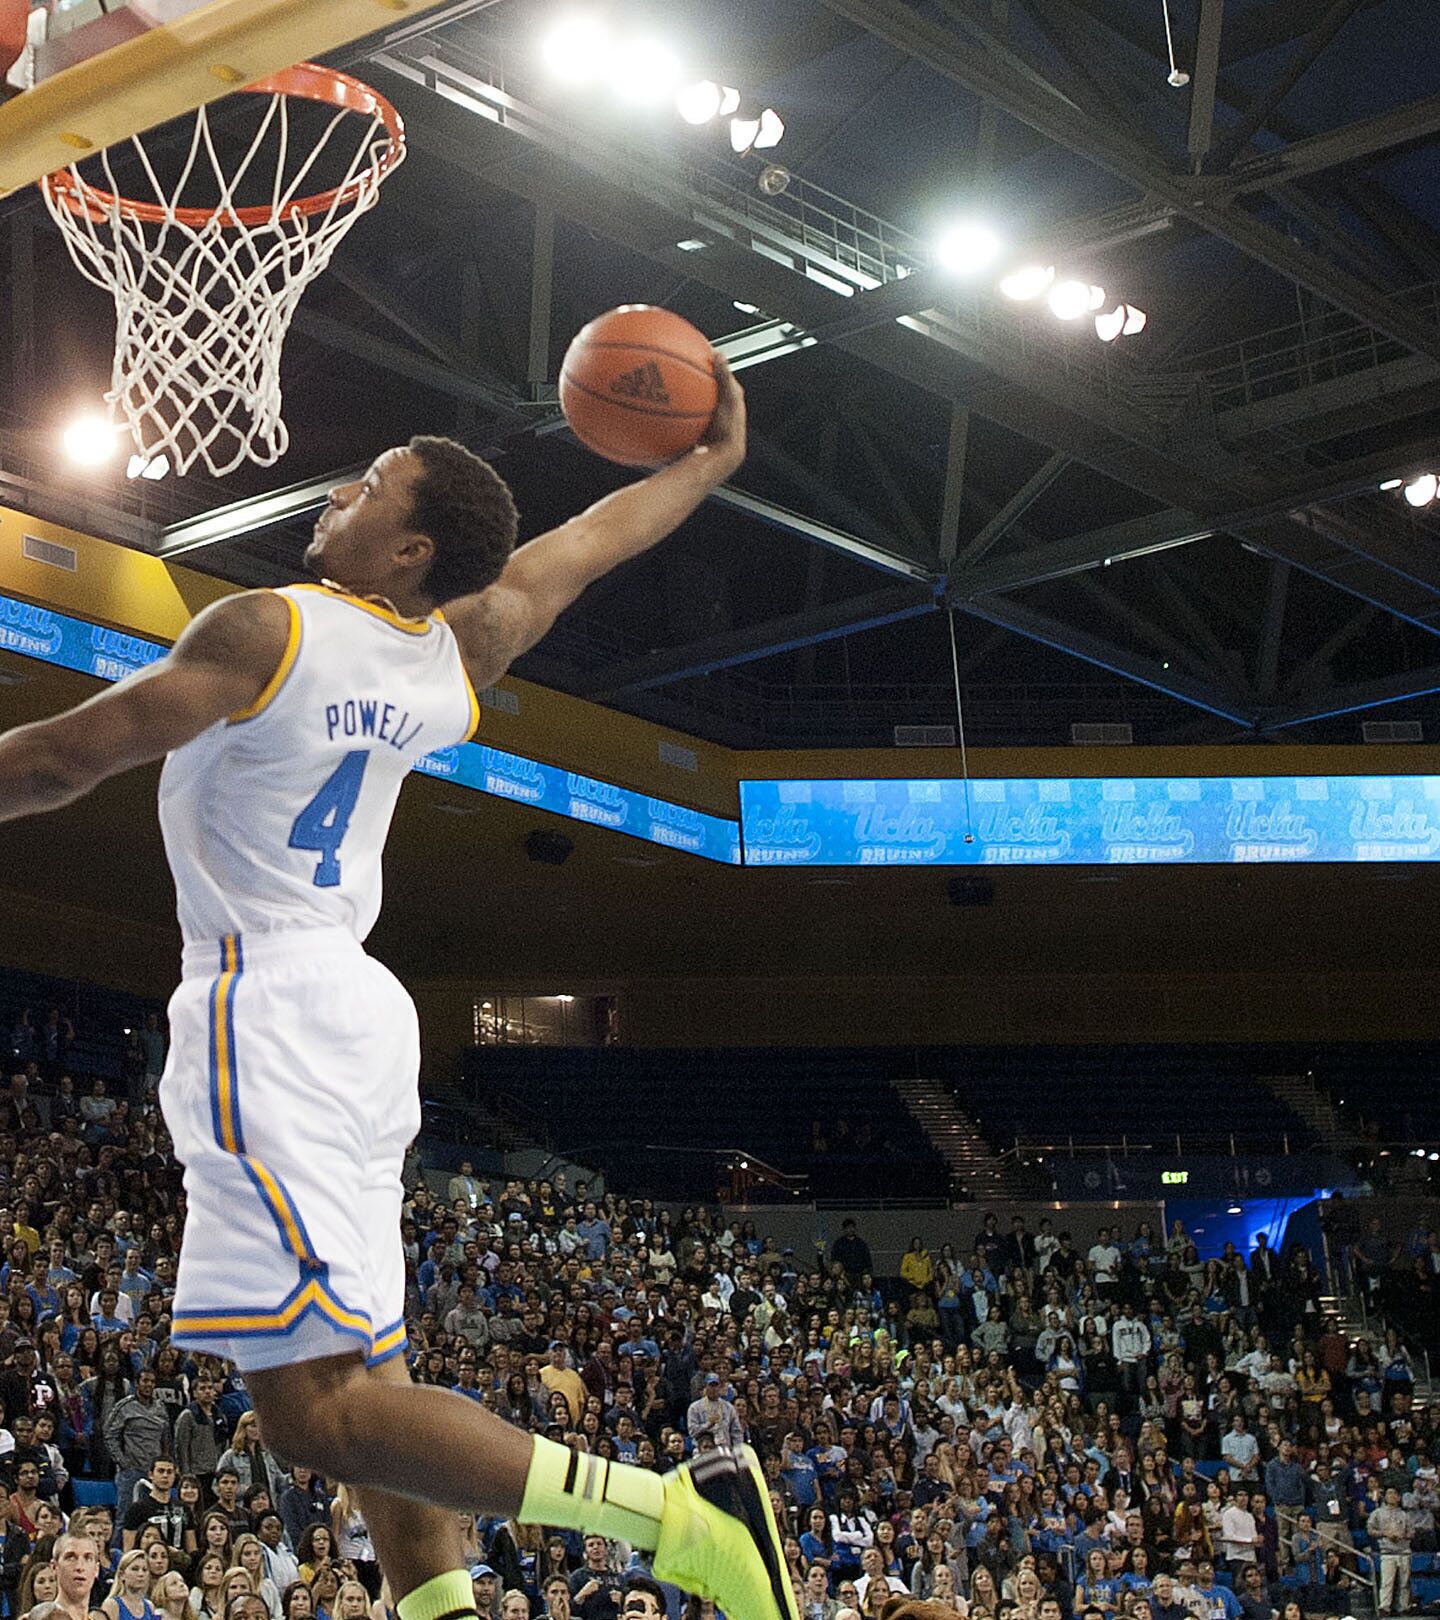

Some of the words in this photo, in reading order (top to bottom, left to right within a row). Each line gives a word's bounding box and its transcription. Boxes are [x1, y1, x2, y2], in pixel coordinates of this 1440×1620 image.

[326, 698, 423, 750] POWELL
[288, 749, 370, 888] 4
[860, 848, 936, 863] BRUINS
[1161, 1171, 1189, 1184] EXIT
